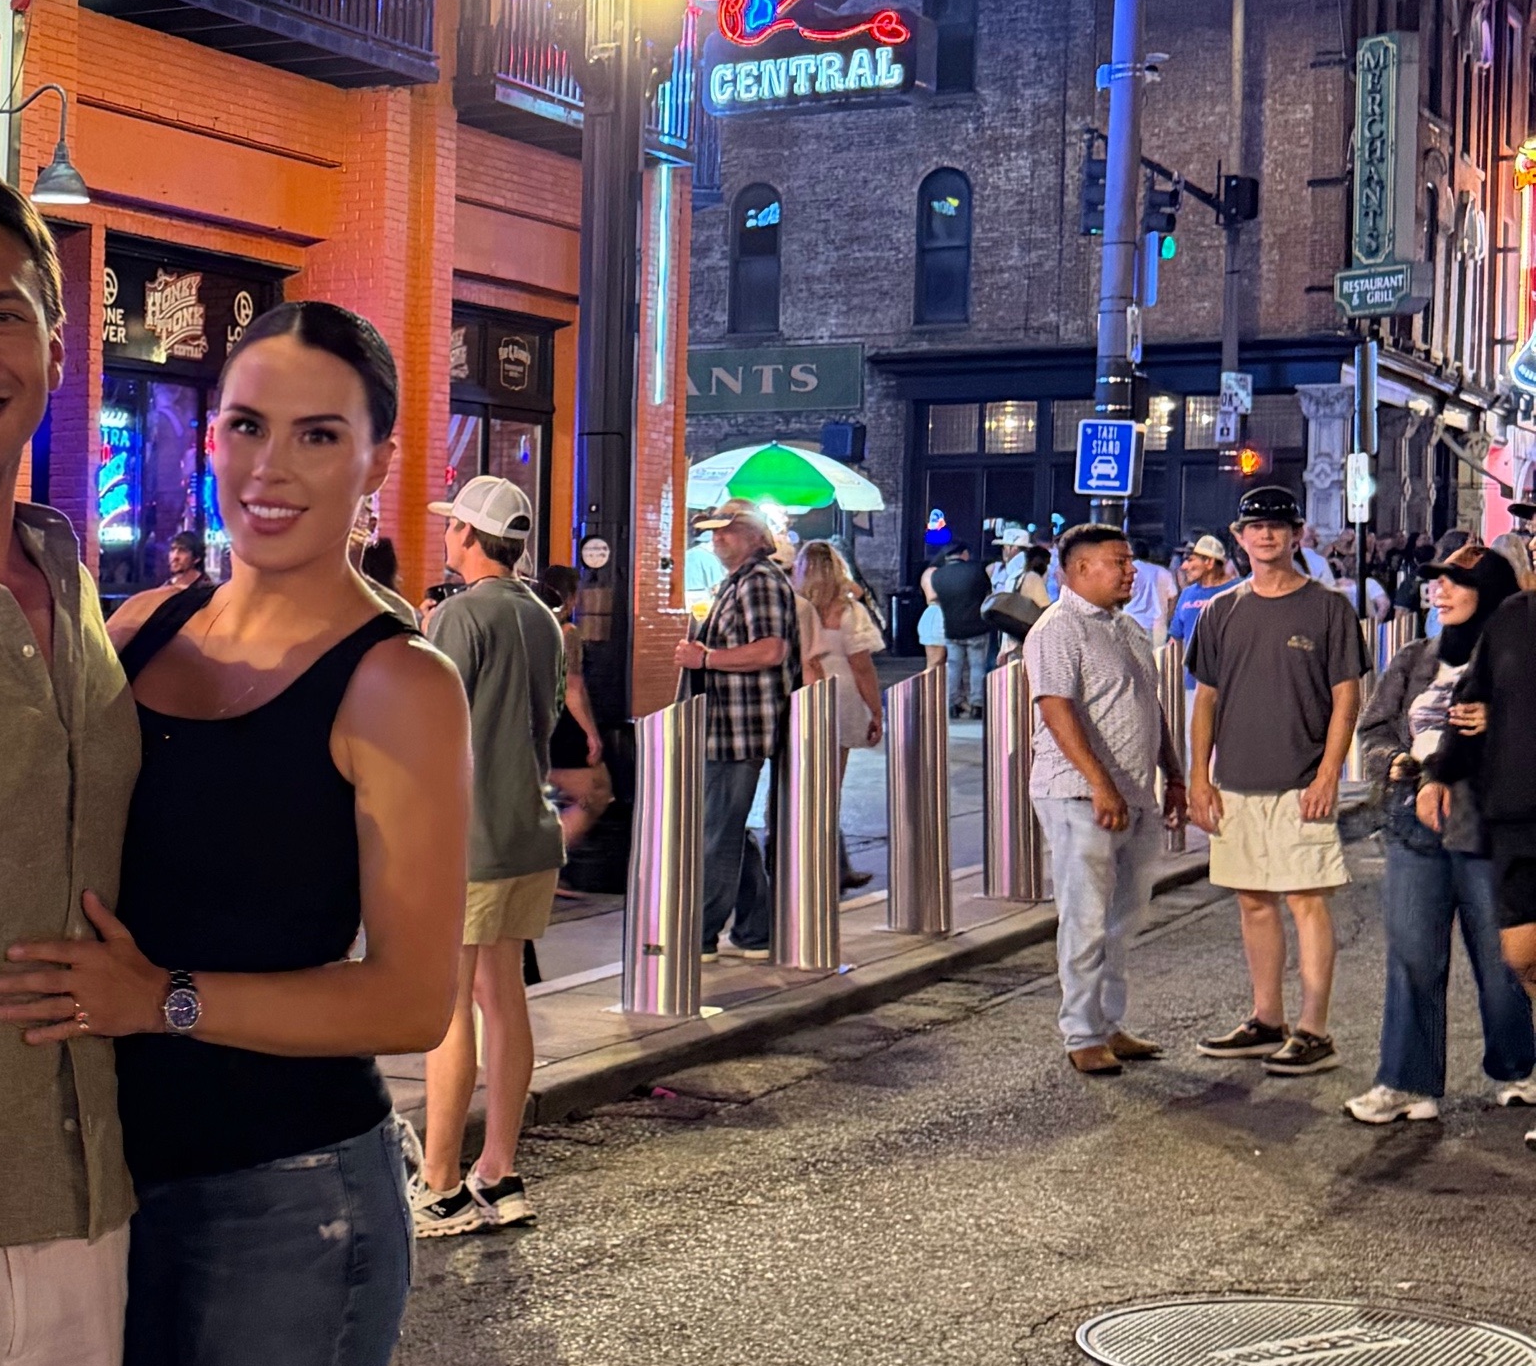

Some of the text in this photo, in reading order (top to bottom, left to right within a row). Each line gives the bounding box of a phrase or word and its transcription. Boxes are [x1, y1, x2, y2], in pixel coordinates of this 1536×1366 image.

[709, 45, 905, 105] CENTRAL
[1363, 46, 1390, 254] MERCHANTS
[146, 275, 201, 325] HONKY
[1343, 274, 1404, 294] RESTAURANT
[1366, 290, 1394, 305] GRILL
[156, 306, 205, 363] TONK
[1091, 439, 1120, 455] STAND
[1098, 425, 1117, 440] TAXI
